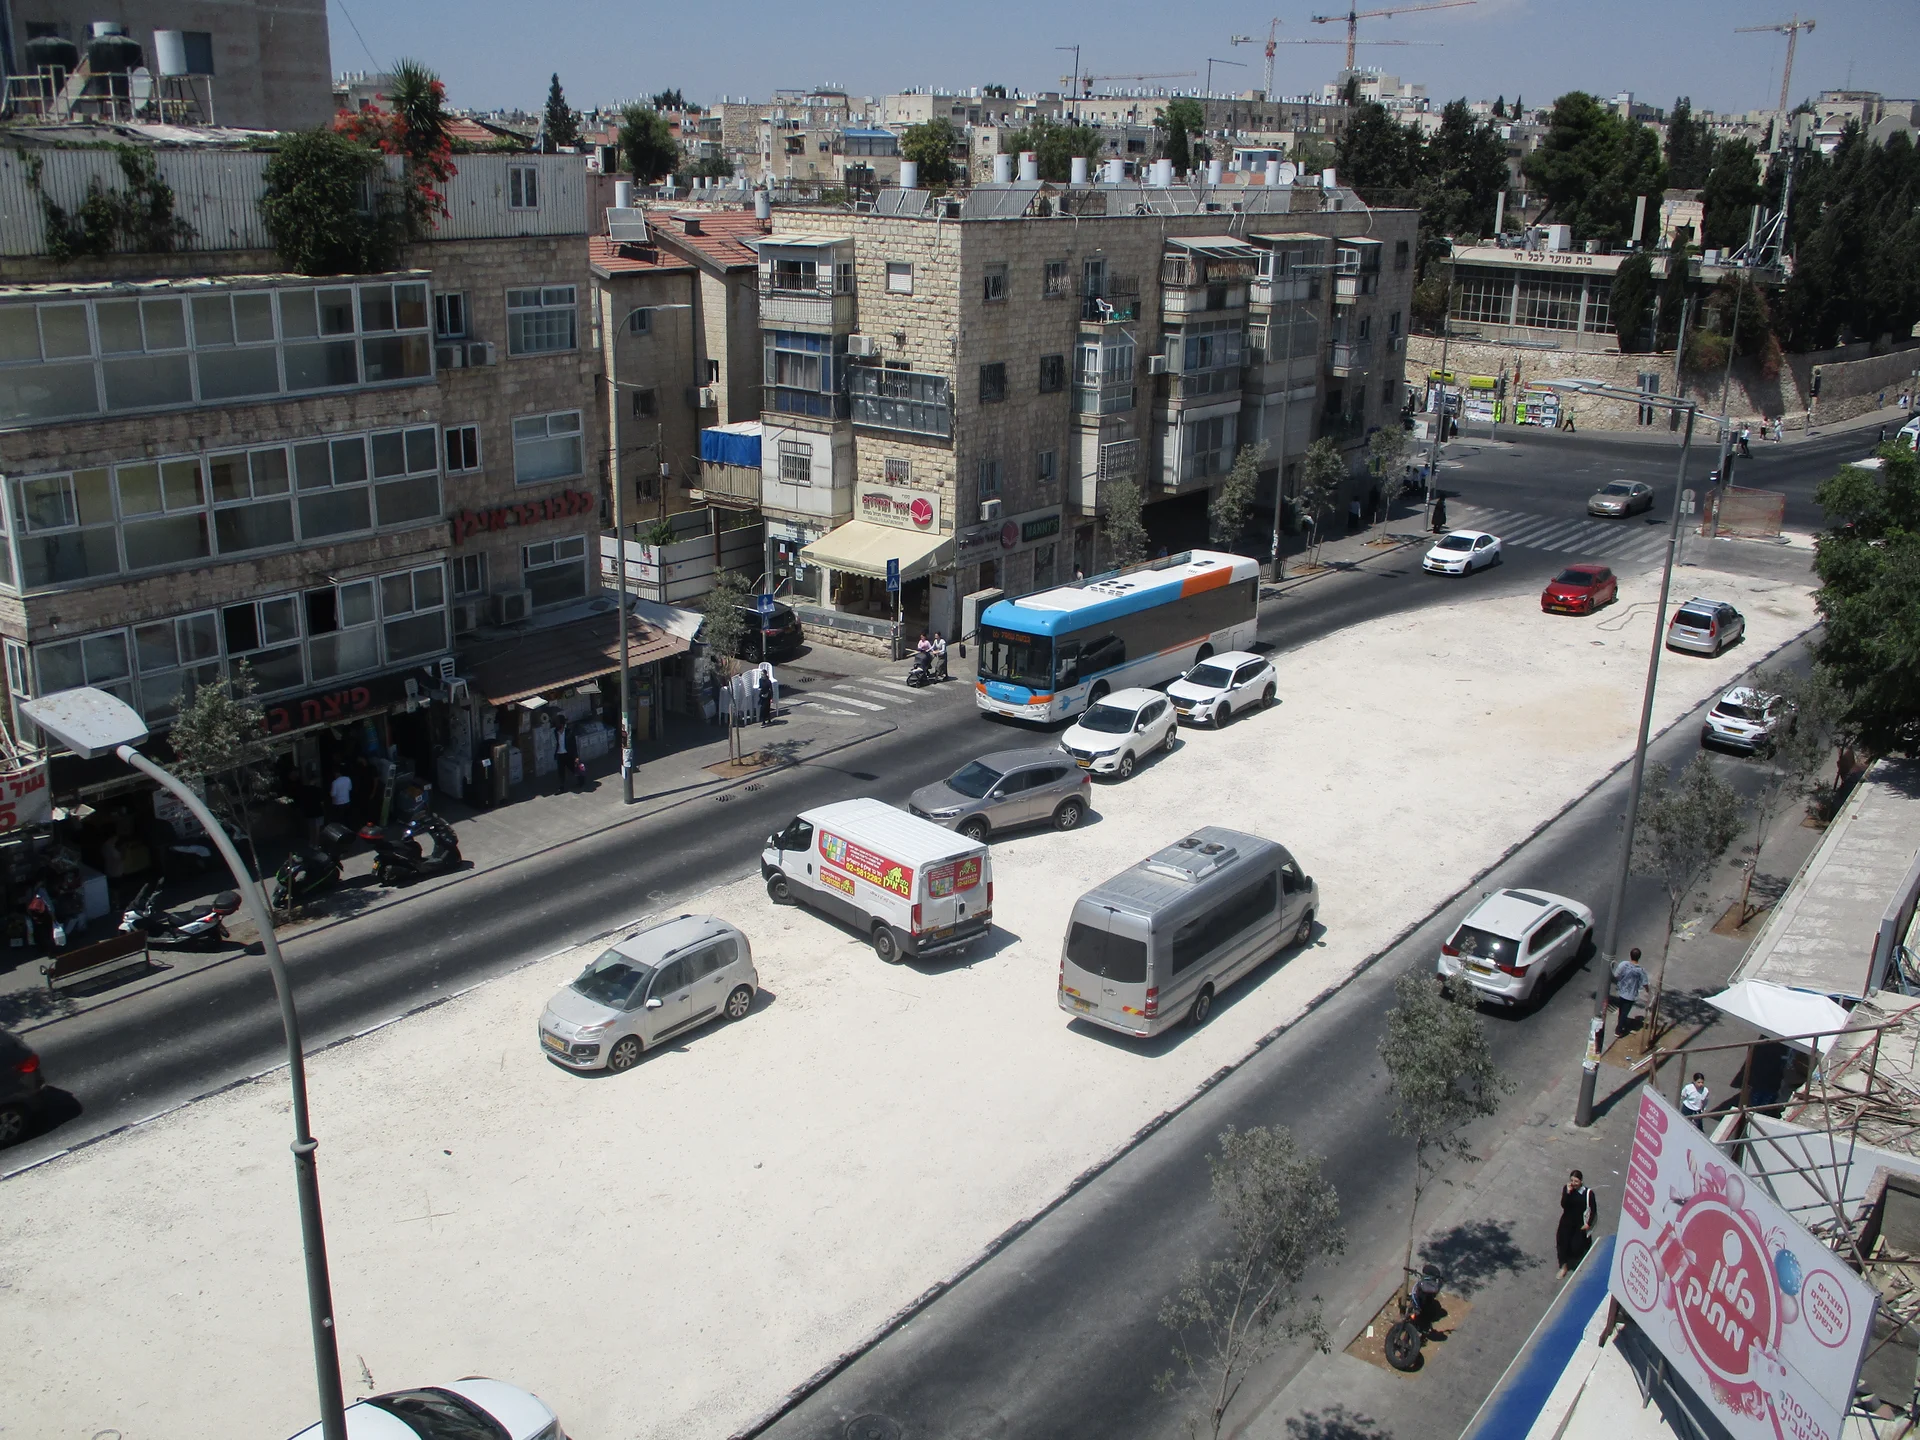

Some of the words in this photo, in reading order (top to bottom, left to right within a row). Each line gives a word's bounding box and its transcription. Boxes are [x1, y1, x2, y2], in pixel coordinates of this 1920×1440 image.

[1514, 252, 1523, 261] חי
[1528, 251, 1545, 262] לכל
[1549, 254, 1571, 264] מועד
[1576, 256, 1592, 265] בית
[512, 502, 540, 526] בר
[545, 489, 593, 520] כלבו
[454, 508, 508, 546] אילן
[1026, 519, 1059, 538] MANNY'S
[301, 686, 370, 726] פיצה
[900, 884, 909, 896] בר
[1708, 1260, 1755, 1320] בלון
[1817, 1282, 1844, 1315] מוצרים
[1684, 1276, 1745, 1352] מתוק
[1810, 1288, 1843, 1330] וממתקים
[1811, 1304, 1833, 1335] בשקל
[1786, 1392, 1830, 1440] הכניסה
